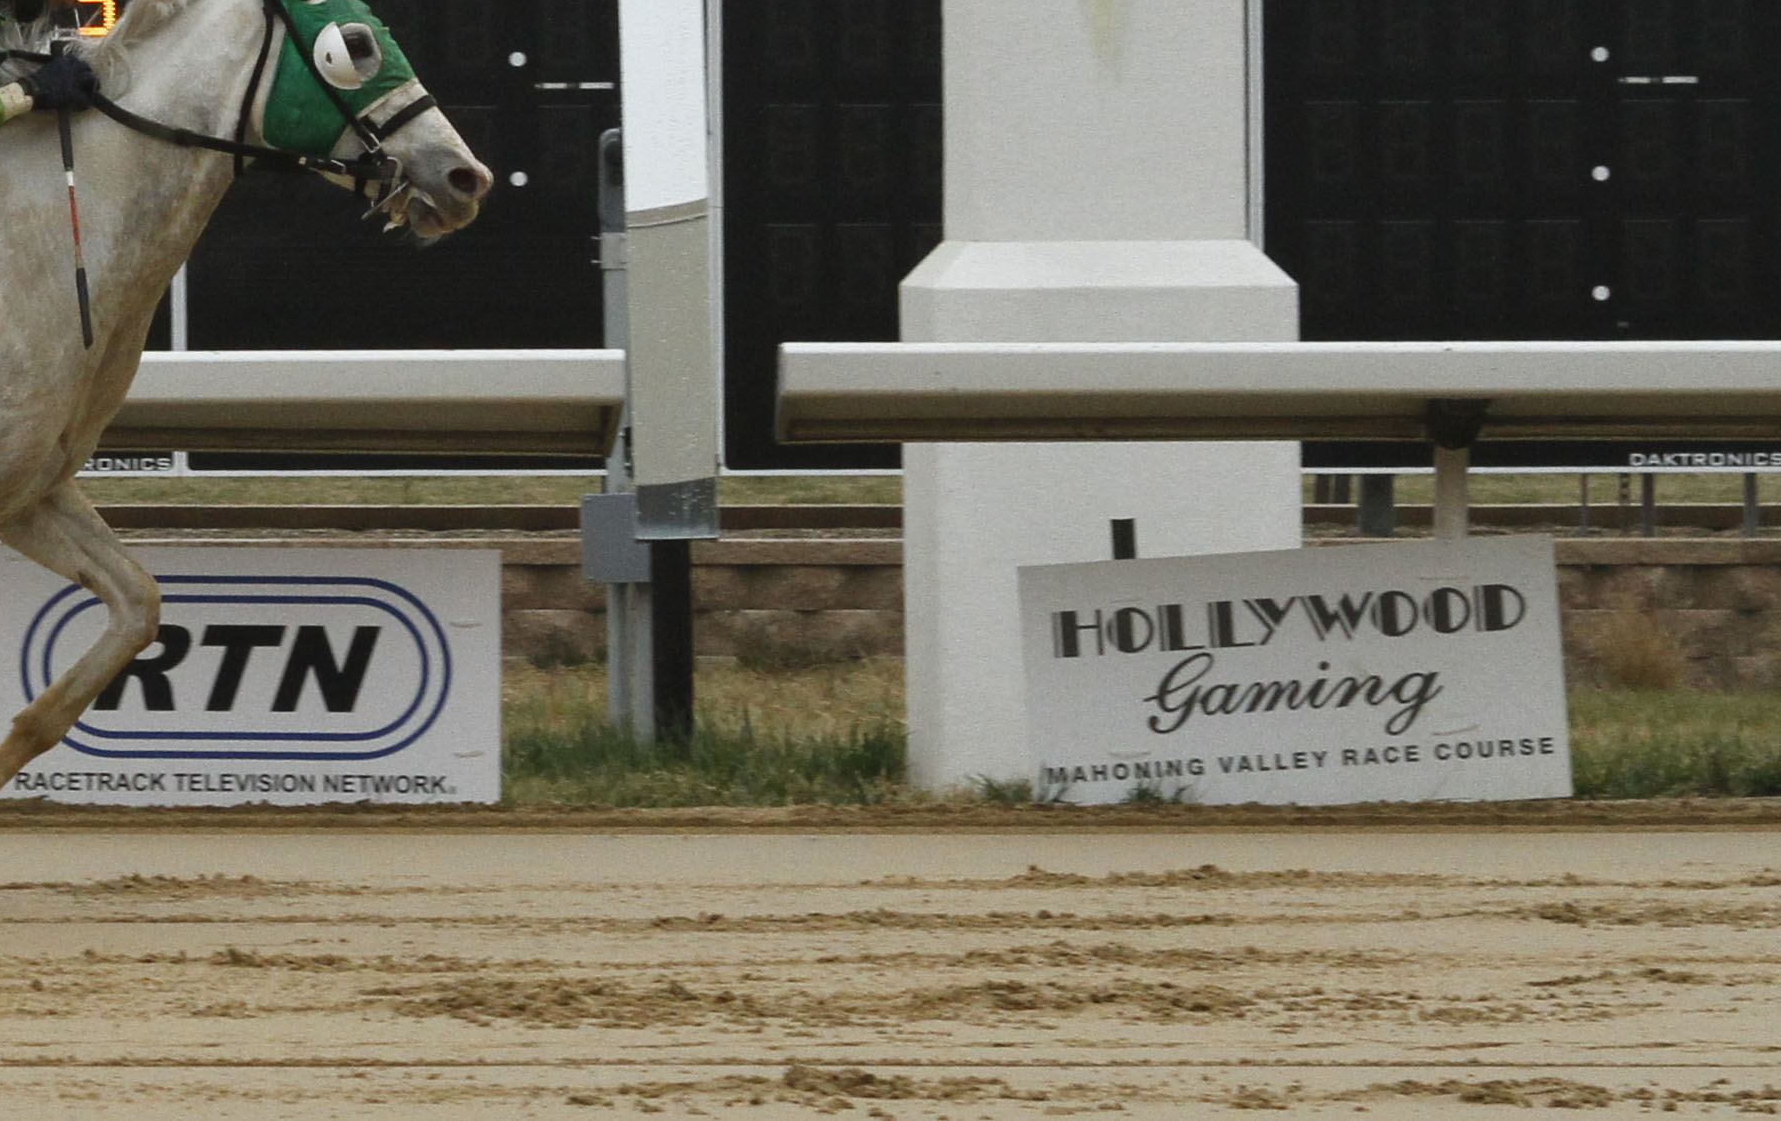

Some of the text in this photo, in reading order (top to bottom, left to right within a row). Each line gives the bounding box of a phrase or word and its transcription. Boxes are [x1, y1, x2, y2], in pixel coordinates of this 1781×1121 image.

[1629, 452, 1781, 466] DAKTRONICS
[1052, 583, 1527, 659] HOLLYWOOD
[91, 624, 381, 713] RTN
[1143, 652, 1443, 736] Gaming
[15, 772, 166, 792] RACETRACK
[172, 772, 316, 794] TELEVISION
[1047, 737, 1555, 784] MAHONING VALLEY RACE COURSE
